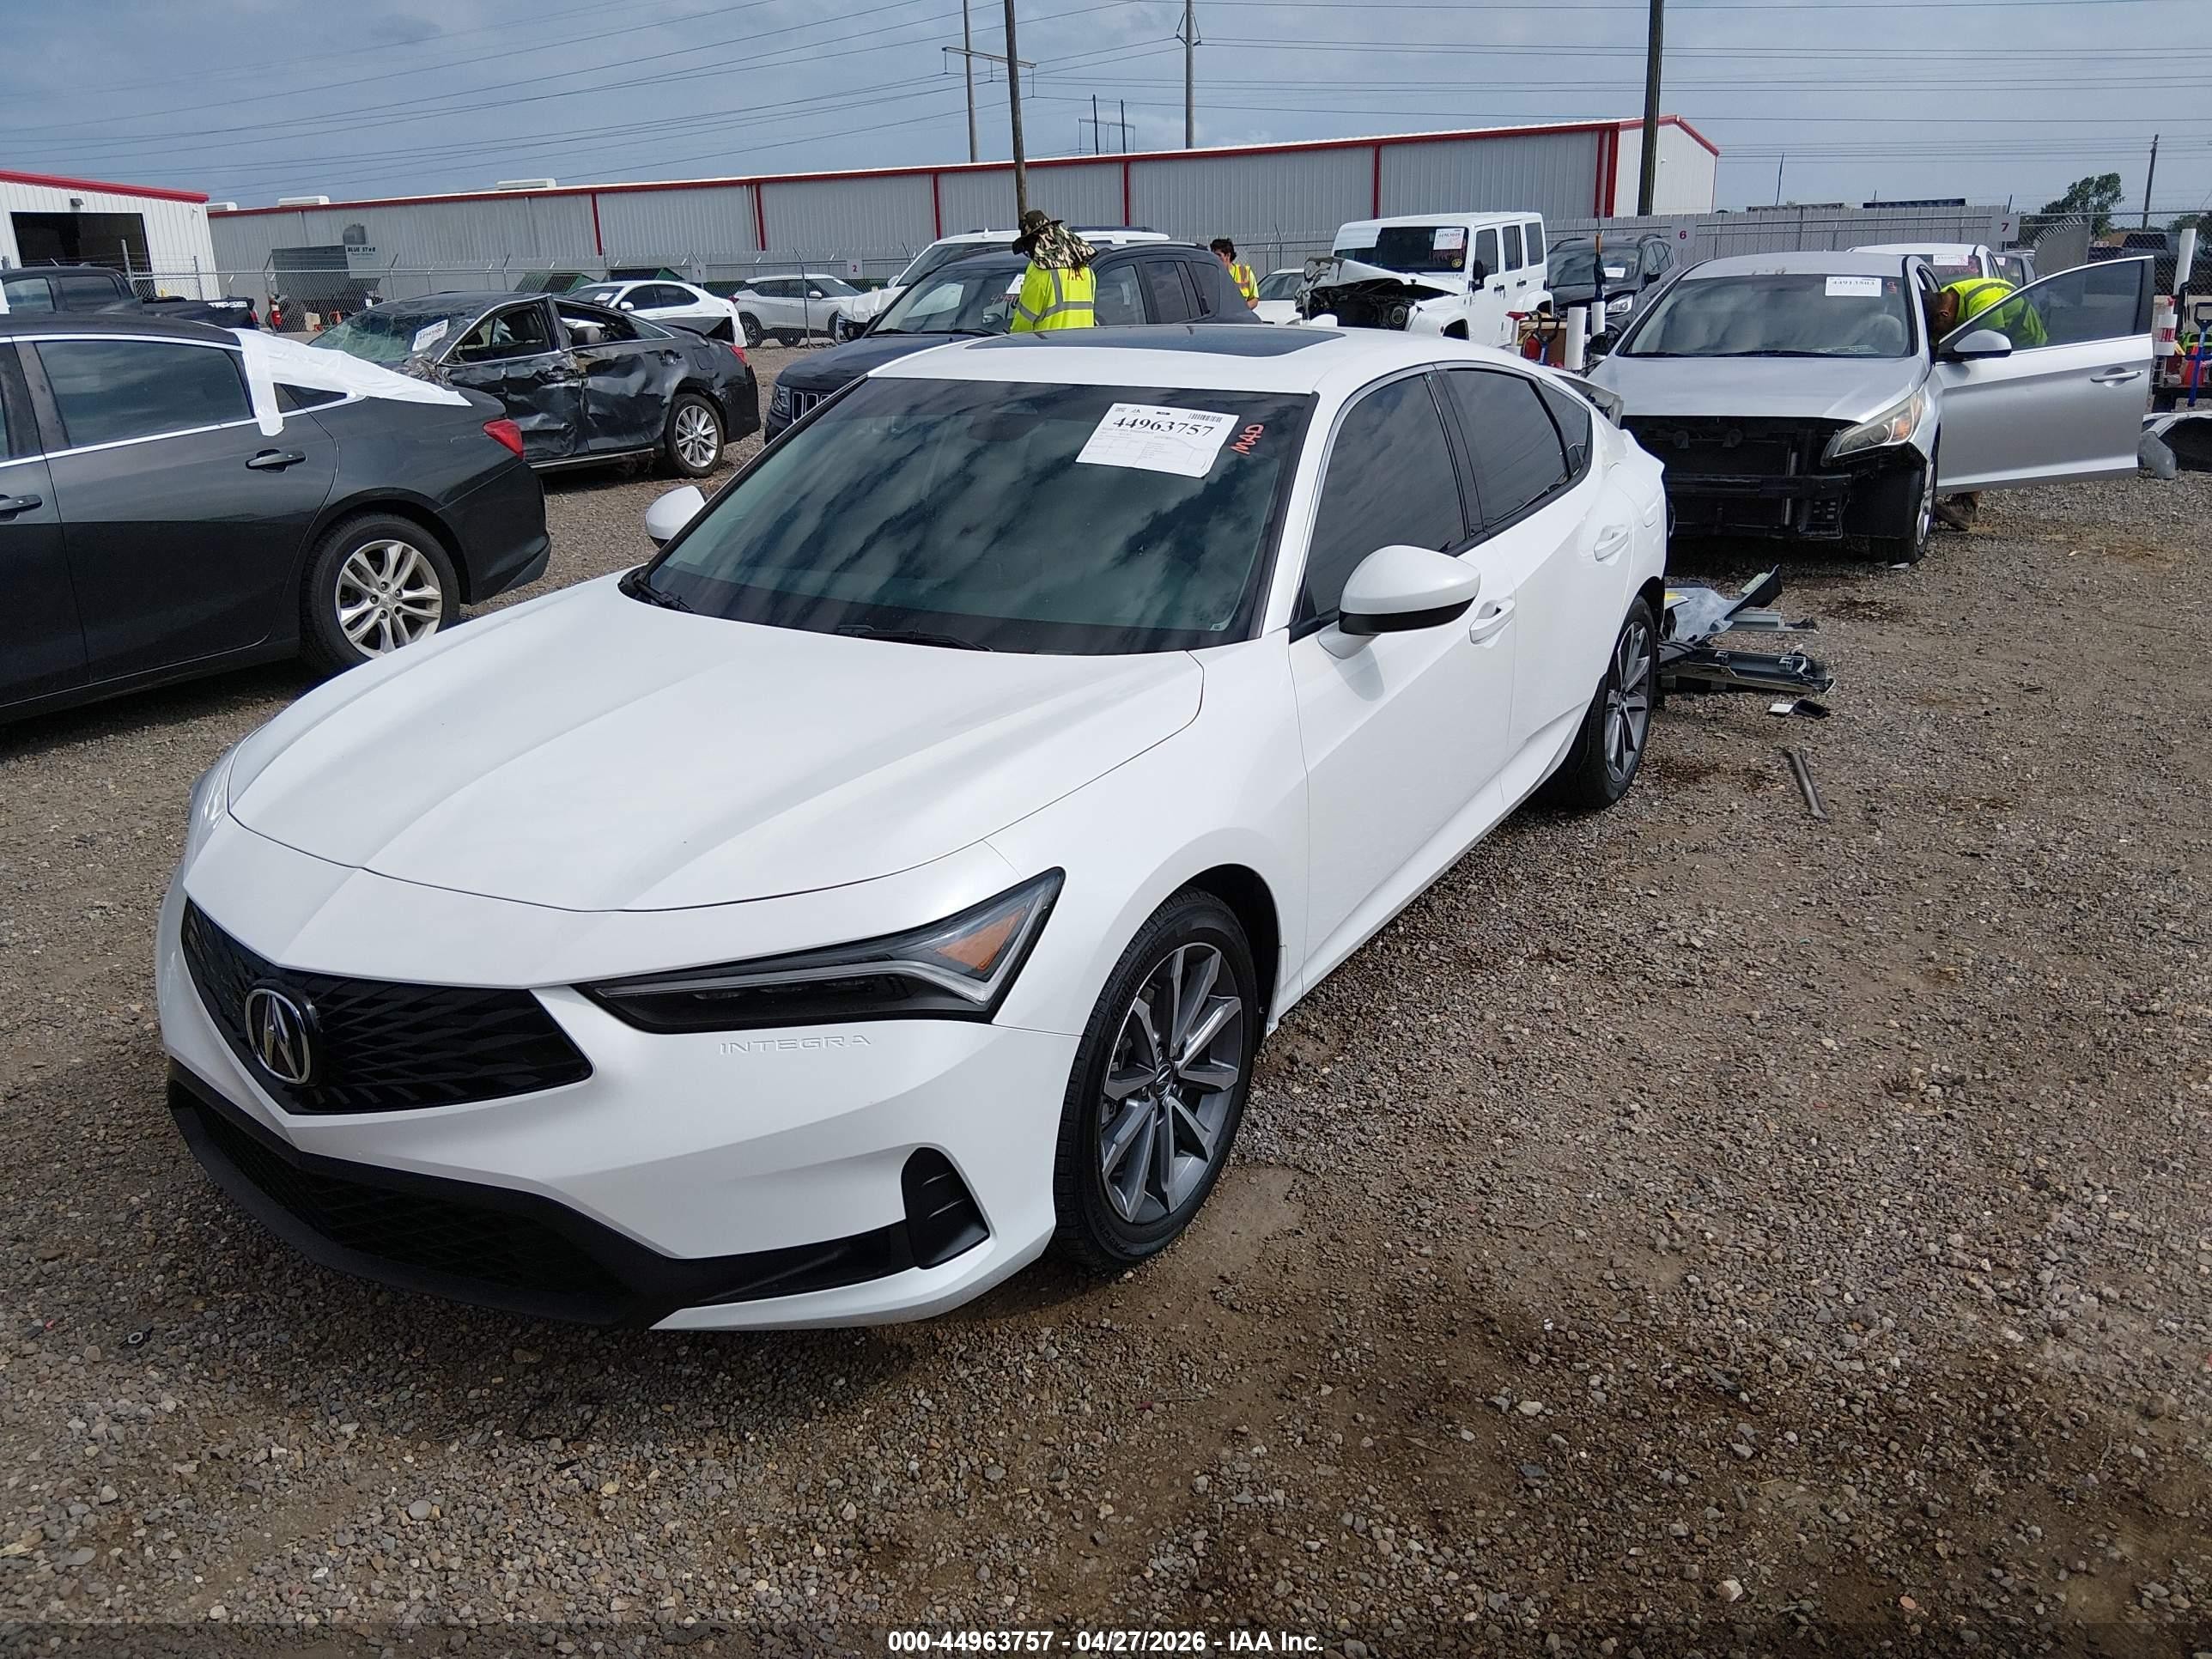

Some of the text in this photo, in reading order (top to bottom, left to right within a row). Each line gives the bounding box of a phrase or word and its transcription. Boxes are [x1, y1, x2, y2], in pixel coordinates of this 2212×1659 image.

[2001, 222, 2009, 232] 7
[1679, 230, 1687, 240] 6
[852, 264, 858, 273] 2
[1113, 417, 1214, 436] 44963757
[1230, 424, 1264, 455] MAD
[720, 1035, 872, 1055] INTEGRA
